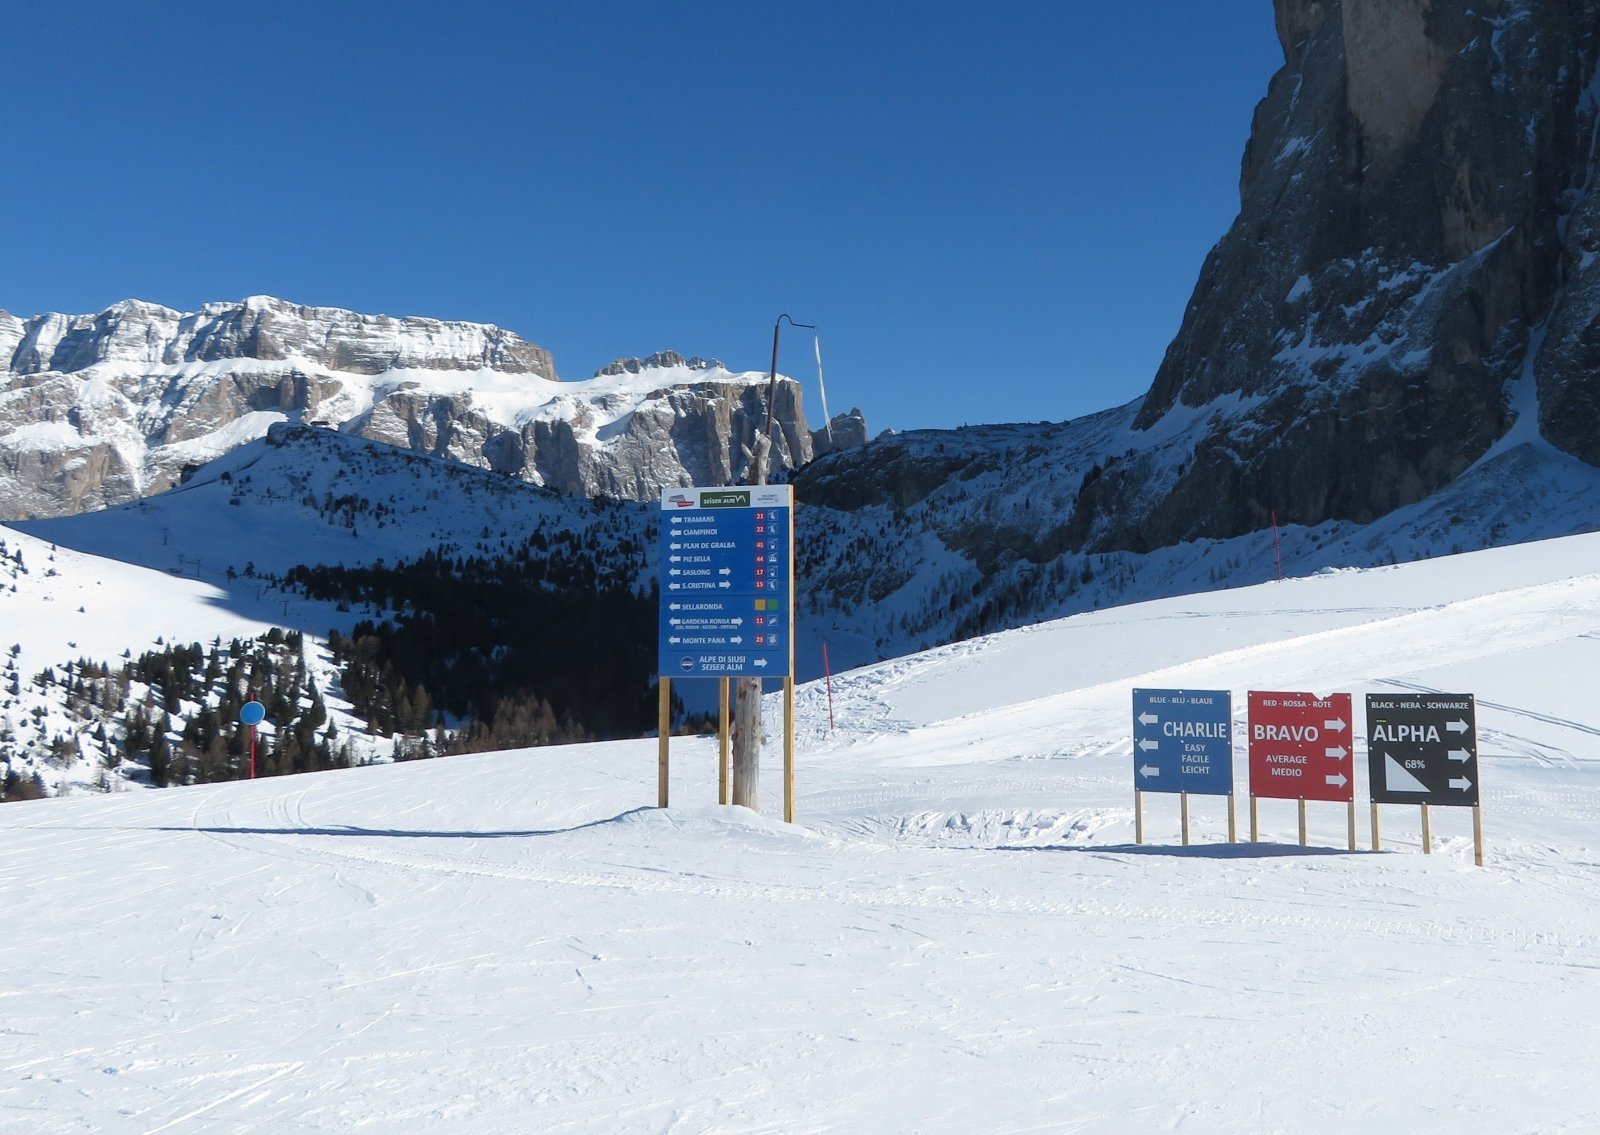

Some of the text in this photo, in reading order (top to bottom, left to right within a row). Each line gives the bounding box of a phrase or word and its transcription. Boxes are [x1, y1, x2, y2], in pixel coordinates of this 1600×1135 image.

[1164, 722, 1226, 738] CHARLIE
[1254, 725, 1319, 742] BRAVO
[1373, 725, 1441, 742] ALPHA
[1266, 755, 1307, 764] AVERAGE
[1405, 760, 1425, 768] 68%
[1272, 768, 1302, 776] MEDIO
